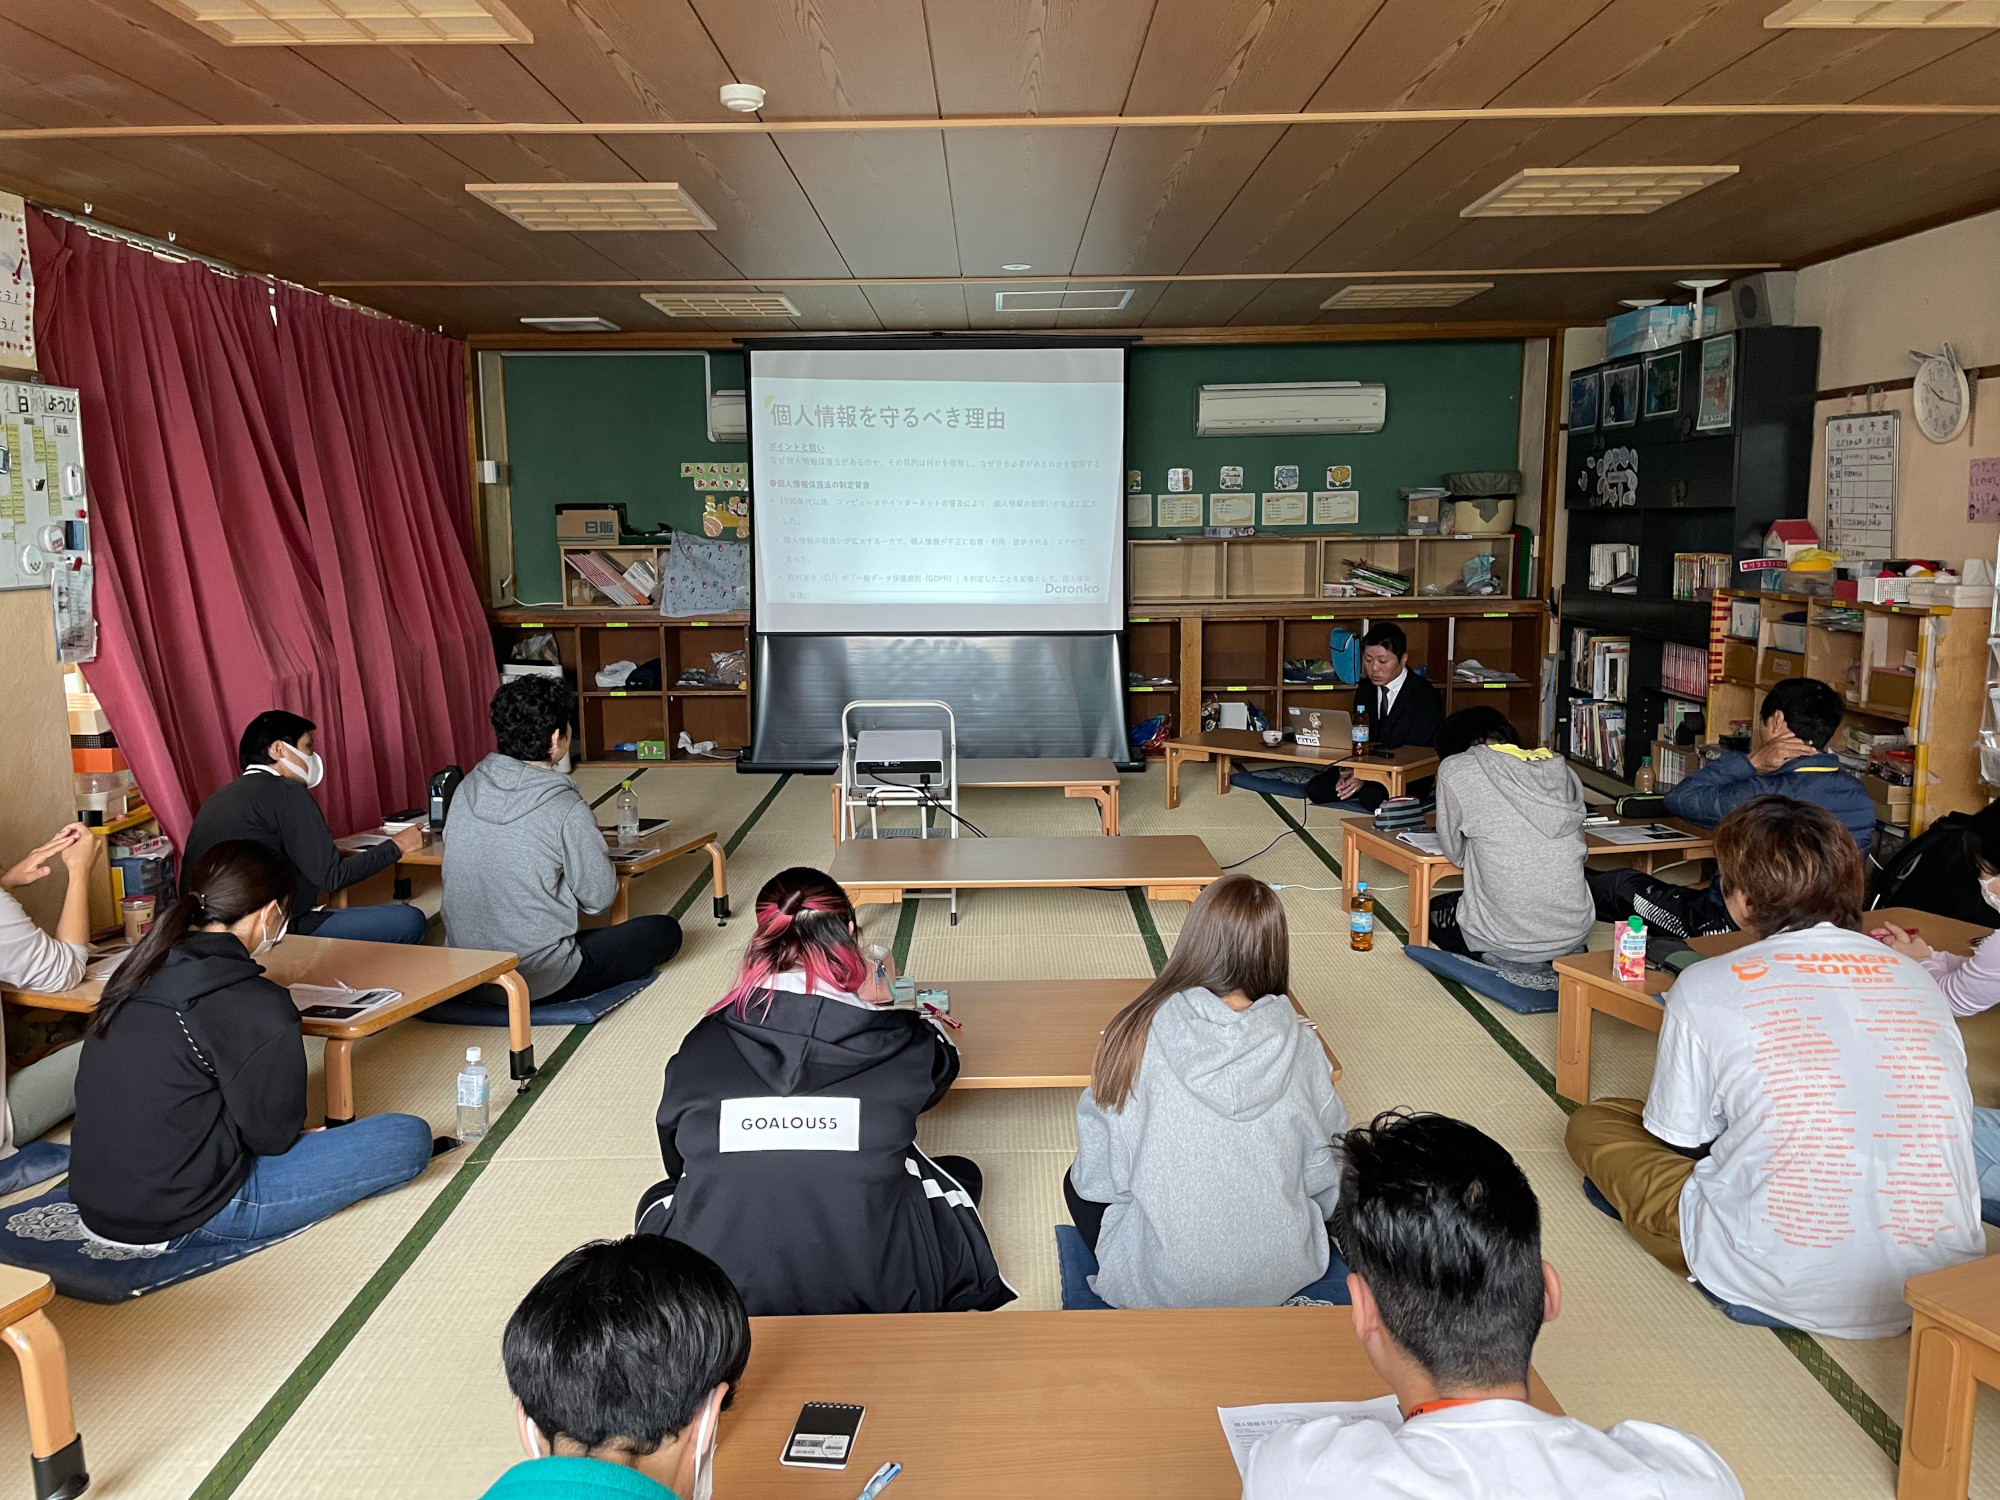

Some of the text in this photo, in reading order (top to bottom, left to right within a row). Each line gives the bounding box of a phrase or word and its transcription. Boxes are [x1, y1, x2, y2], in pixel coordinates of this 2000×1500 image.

[770, 403, 1006, 430] 個人情報を守るべき理由
[585, 521, 614, 534] 日販
[1045, 583, 1100, 595] Doronko
[1773, 953, 1901, 965] SUMMER
[1795, 963, 1893, 975] SONIC
[741, 1116, 838, 1131] GOALOUS5
